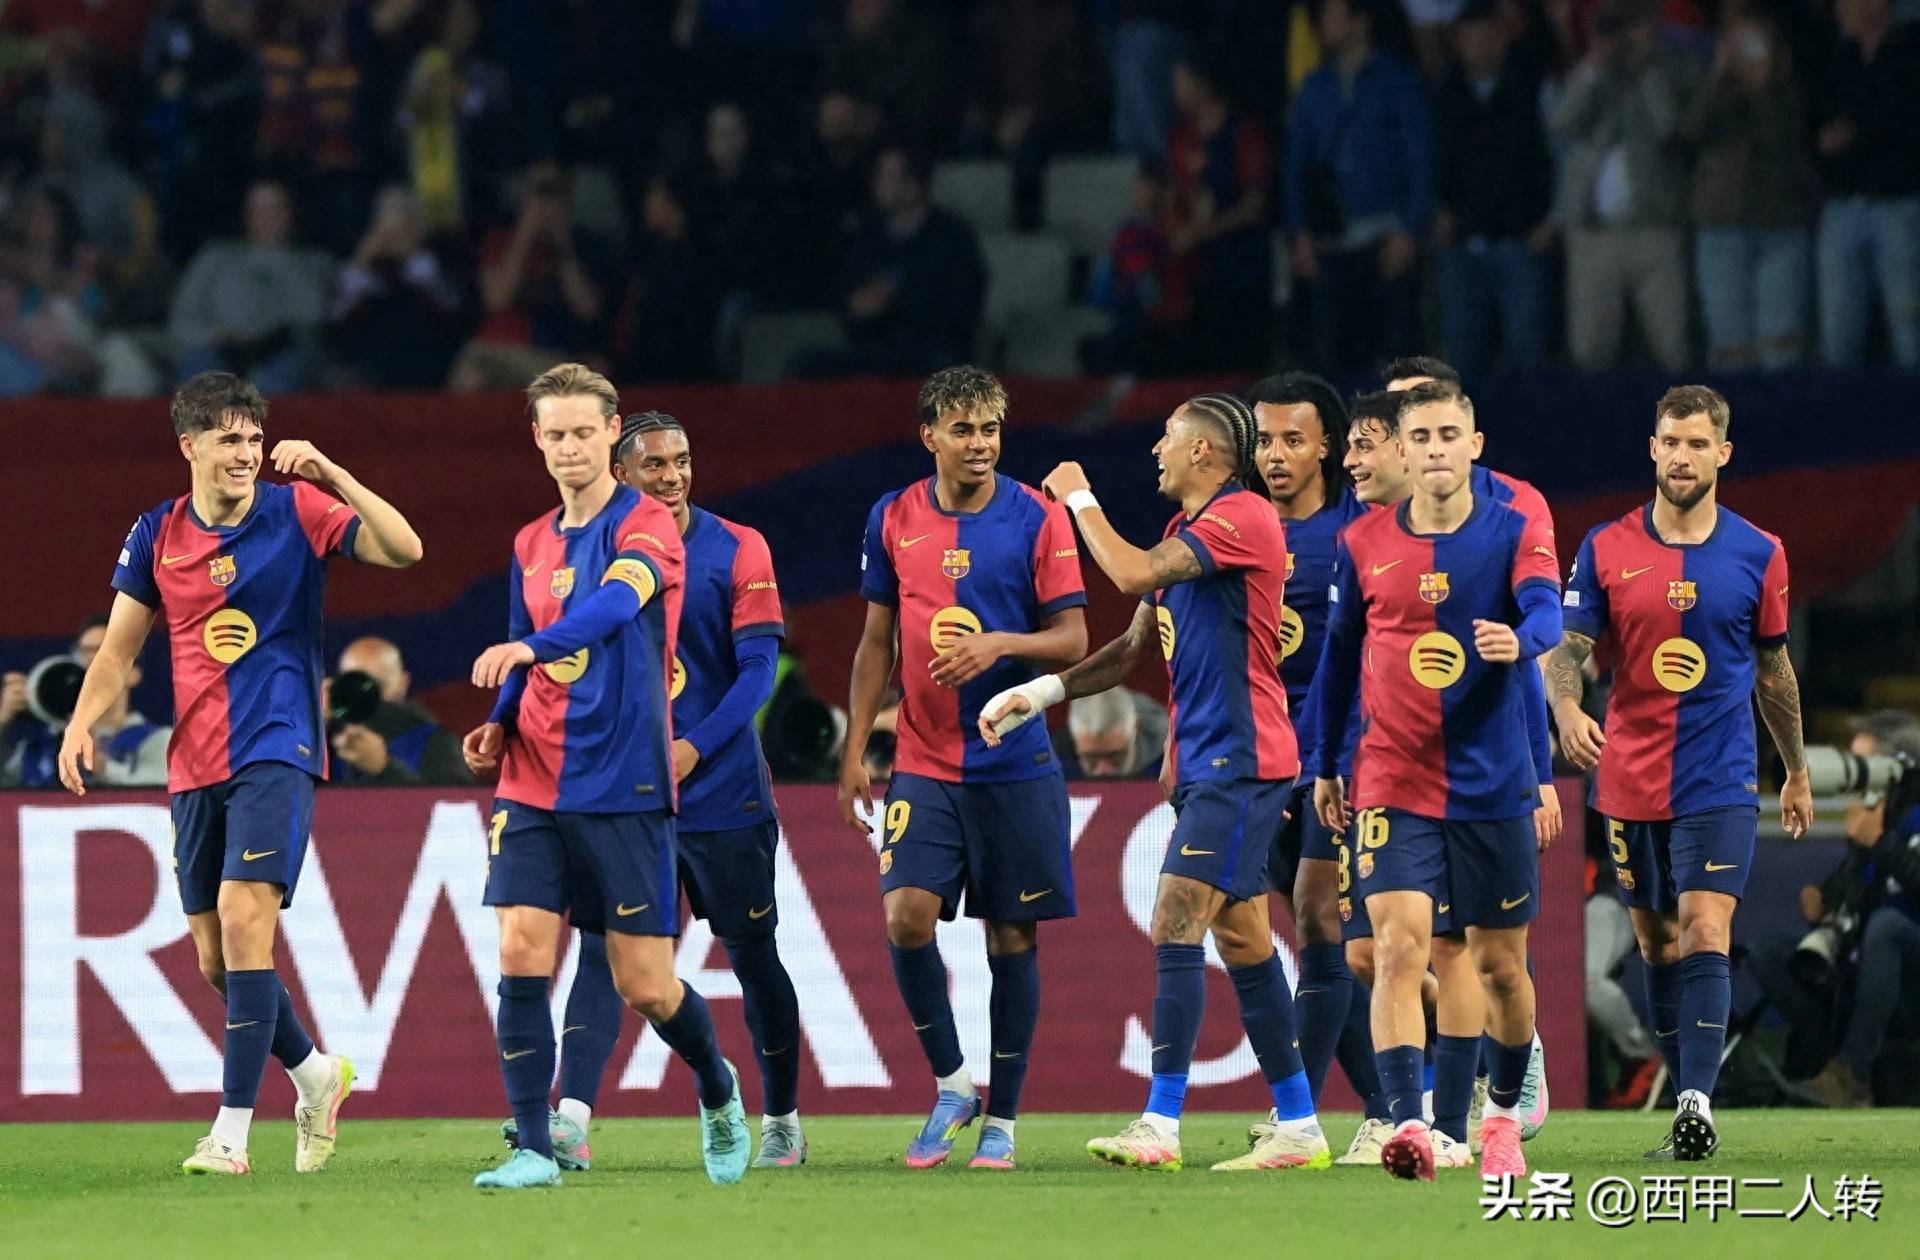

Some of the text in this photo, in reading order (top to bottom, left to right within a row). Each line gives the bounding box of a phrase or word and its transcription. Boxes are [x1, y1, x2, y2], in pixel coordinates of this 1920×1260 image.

[882, 800, 911, 844] 9
[1356, 807, 1389, 853] 16
[1609, 818, 1628, 864] 5
[19, 796, 1299, 1096] RWAYS
